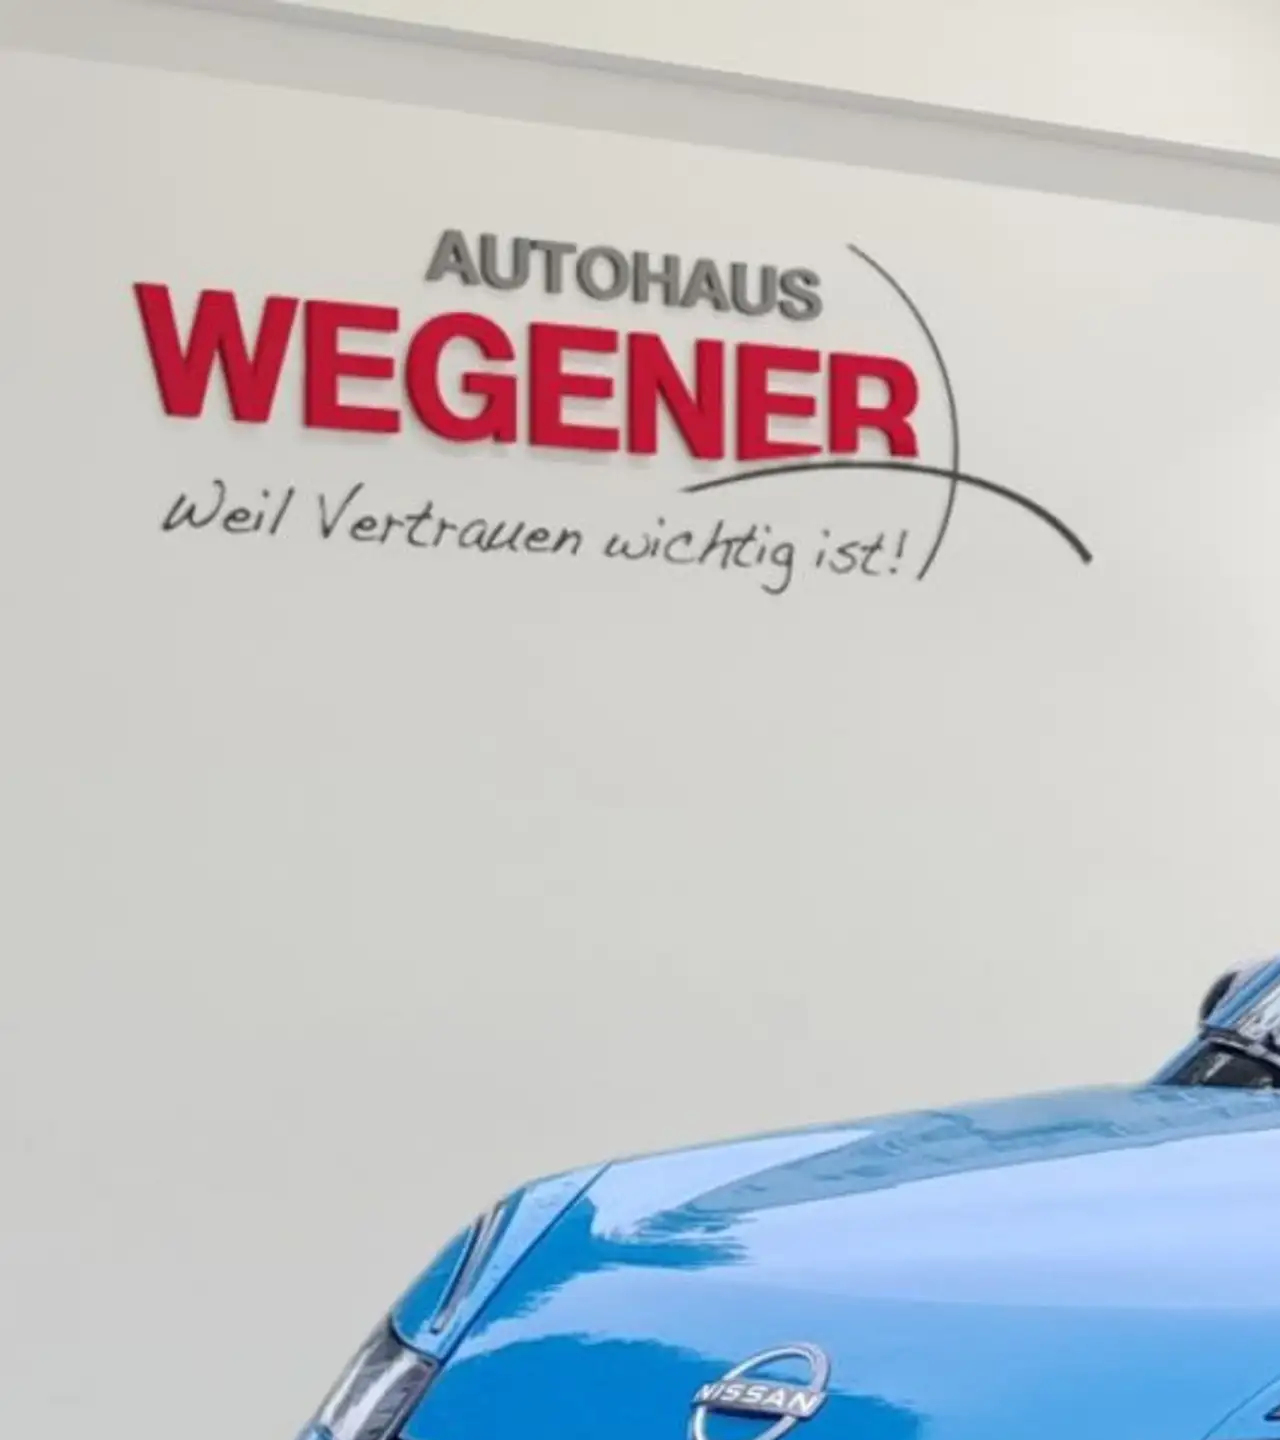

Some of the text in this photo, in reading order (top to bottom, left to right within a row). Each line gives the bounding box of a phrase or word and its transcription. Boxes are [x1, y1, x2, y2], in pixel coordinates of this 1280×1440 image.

[425, 229, 824, 322] AUTOHAUS
[133, 282, 920, 462] WEGENER
[161, 478, 908, 595] Weil Vertrauen wichtig ist!
[699, 1383, 819, 1414] NISSAN
